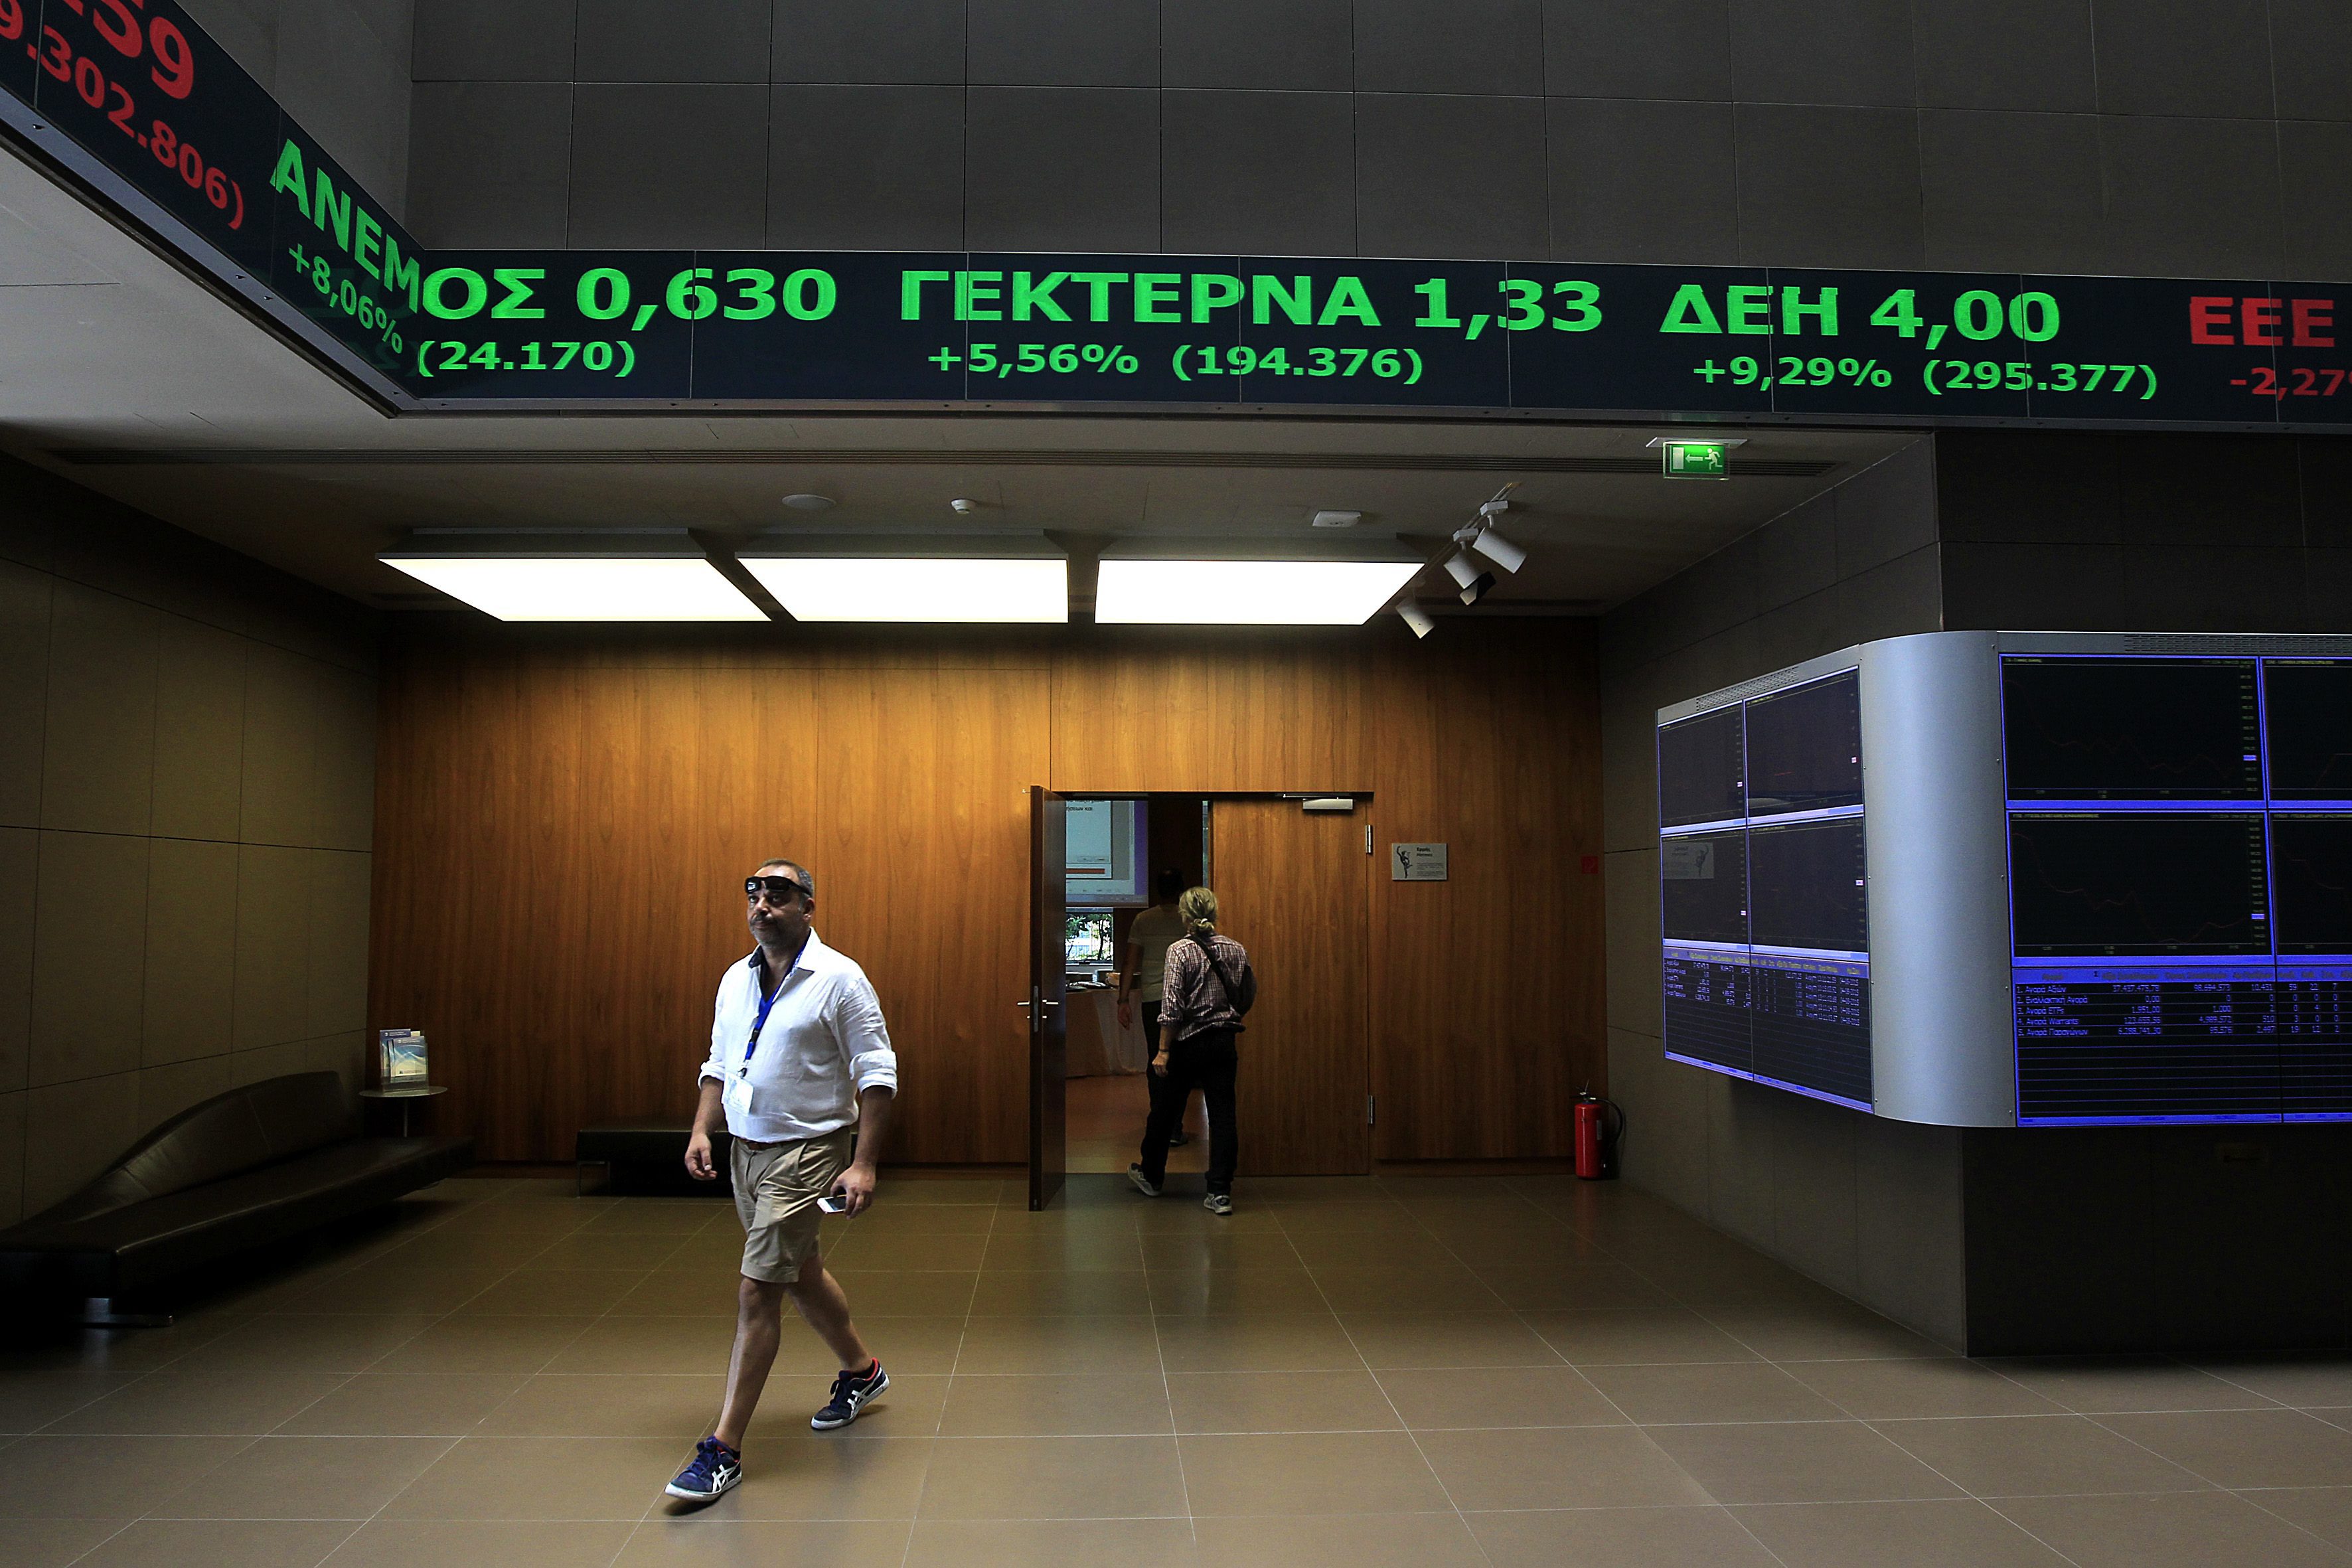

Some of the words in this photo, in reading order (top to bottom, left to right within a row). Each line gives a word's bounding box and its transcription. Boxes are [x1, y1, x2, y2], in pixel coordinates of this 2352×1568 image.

[64, 0, 194, 100] 59
[289, 243, 403, 354] +8,06%
[418, 341, 635, 378] (24.170)
[576, 268, 837, 331] 0,630
[901, 270, 1381, 327] ΓΕΚΤΕΡΝΑ
[1414, 278, 1603, 341] 1,33
[1659, 283, 1839, 336] ΔΕΗ
[1870, 289, 2060, 351] 4,00
[928, 343, 1139, 378] +5,56%
[1172, 345, 1423, 385] (194.376)
[1693, 356, 1892, 392] +9,29%
[1923, 359, 2157, 400] (295.377)
[2231, 367, 2352, 401] -2,27
